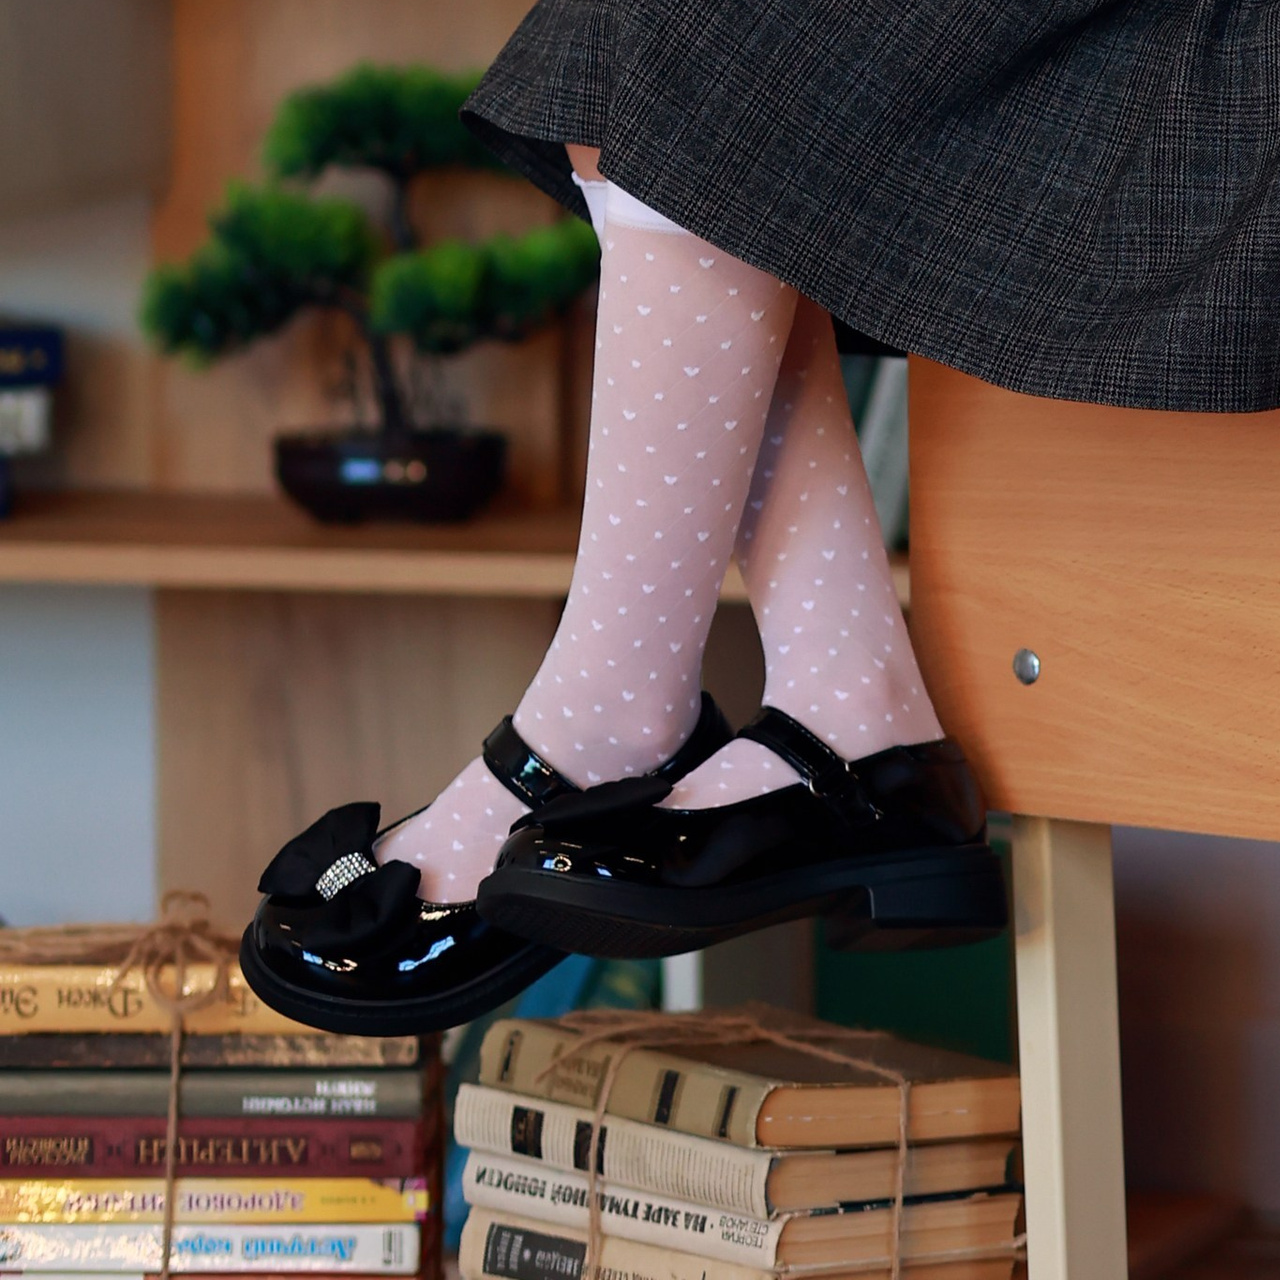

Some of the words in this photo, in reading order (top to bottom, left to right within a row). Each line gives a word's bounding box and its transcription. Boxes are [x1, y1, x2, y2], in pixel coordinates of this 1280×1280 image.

[476, 1166, 547, 1198] ЮНОСТИ
[184, 1189, 304, 1212] ЗДОРОВОЕ
[643, 1204, 681, 1230] ЗАРЕ
[685, 1214, 708, 1233] НА
[241, 1237, 355, 1260] Летучий
